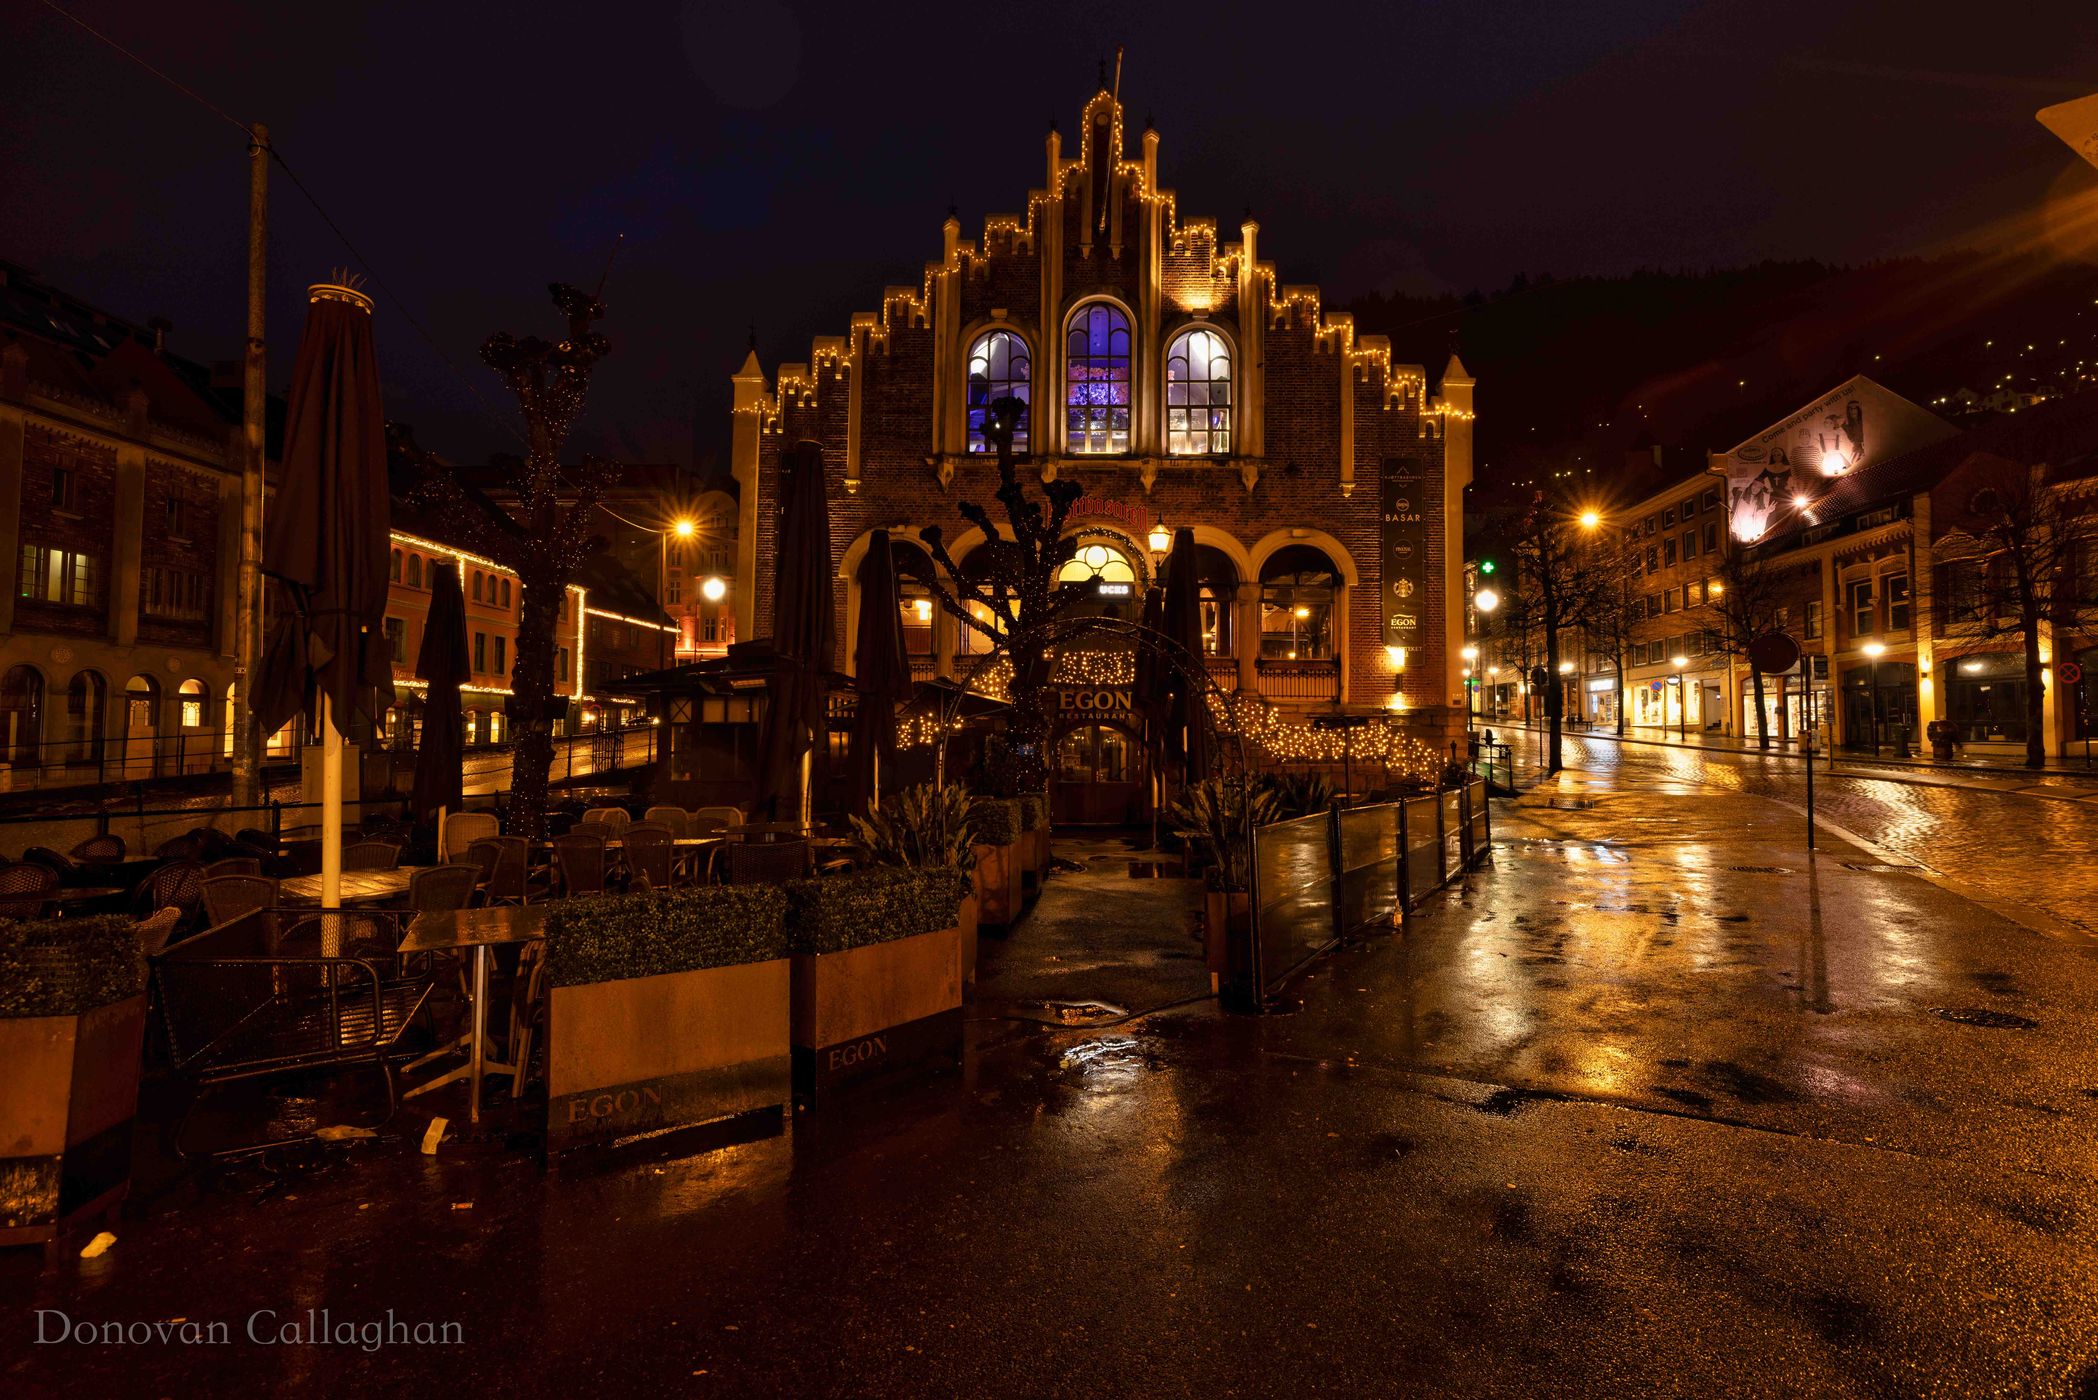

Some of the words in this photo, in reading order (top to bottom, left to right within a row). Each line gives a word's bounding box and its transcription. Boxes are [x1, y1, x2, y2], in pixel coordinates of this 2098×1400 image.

[1762, 427, 1786, 444] Come
[1787, 416, 1802, 430] and
[1803, 405, 1823, 421] party
[1824, 394, 1842, 407] with
[1385, 513, 1421, 522] BASAR
[1391, 618, 1417, 626] EGON
[1058, 690, 1133, 711] EGON
[829, 1036, 888, 1071] EGON
[567, 1084, 663, 1123] EGON
